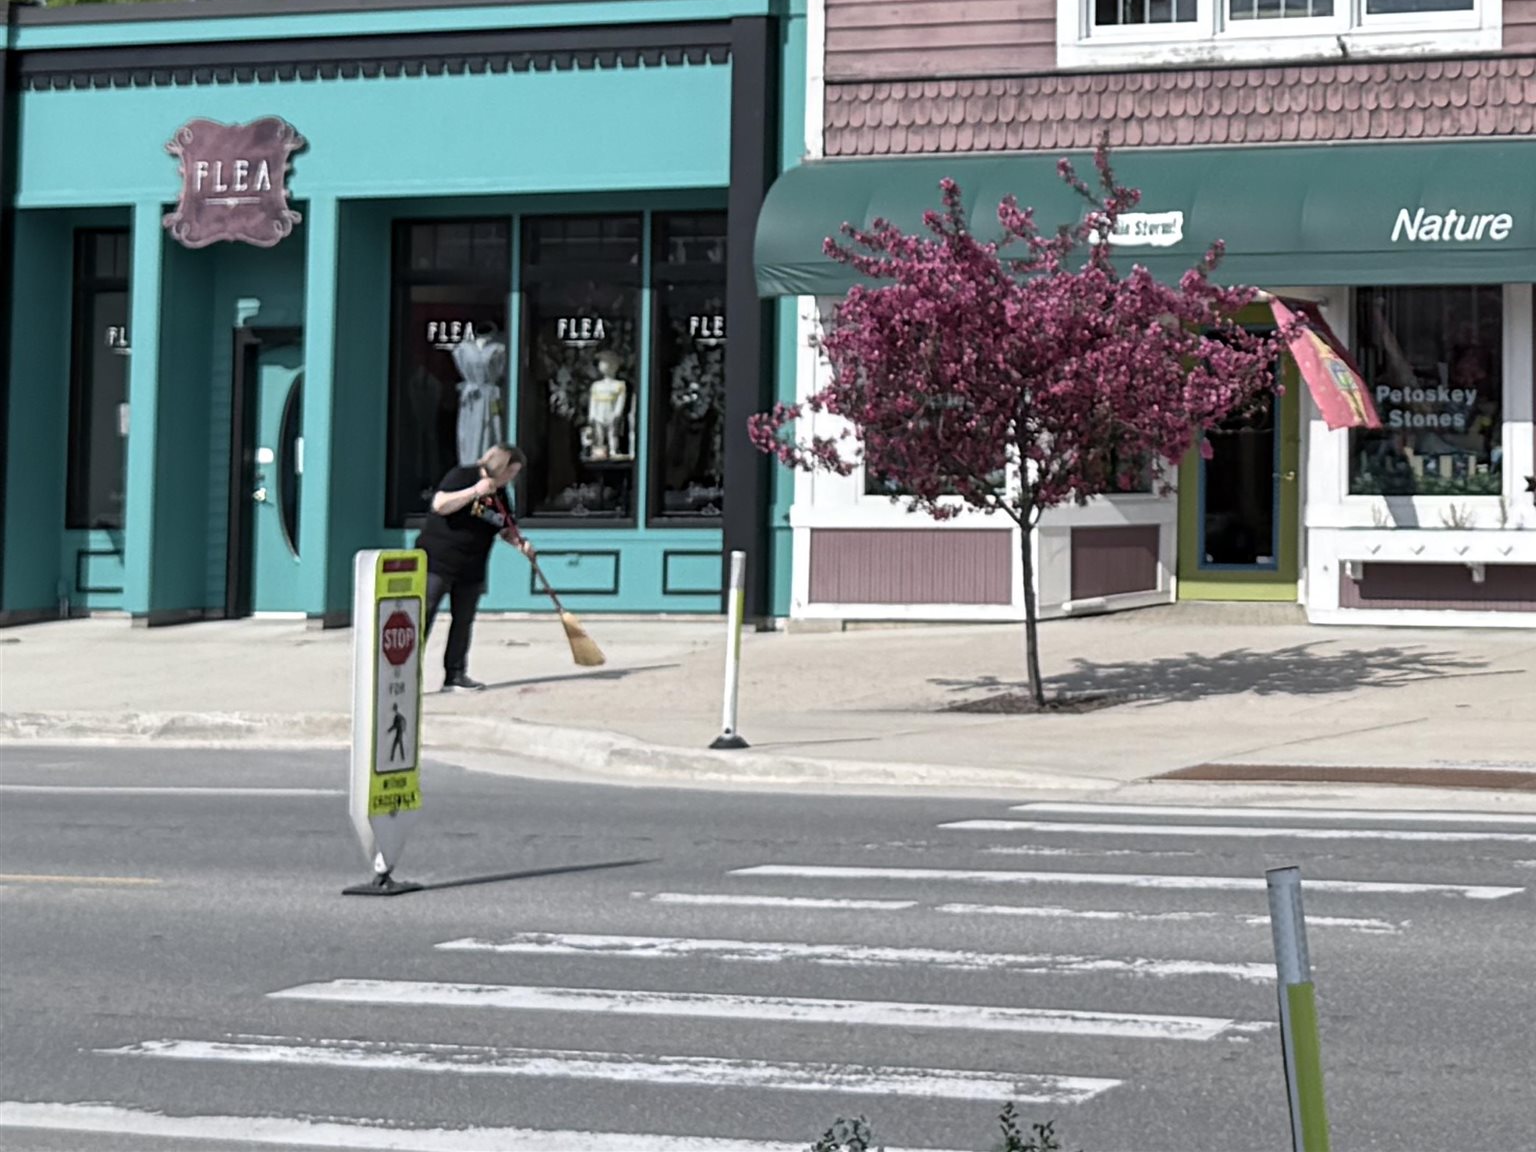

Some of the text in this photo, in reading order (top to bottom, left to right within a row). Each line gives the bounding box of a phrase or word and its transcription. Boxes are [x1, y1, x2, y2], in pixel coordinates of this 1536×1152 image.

[193, 159, 272, 192] FLEA
[1391, 207, 1513, 242] Nature
[106, 326, 129, 346] FL
[427, 321, 476, 343] FLEA
[557, 318, 606, 339] FLEA
[690, 316, 725, 338] FLE
[1376, 385, 1477, 406] Petoskey
[1389, 409, 1466, 428] Stones
[384, 628, 414, 649] STOP
